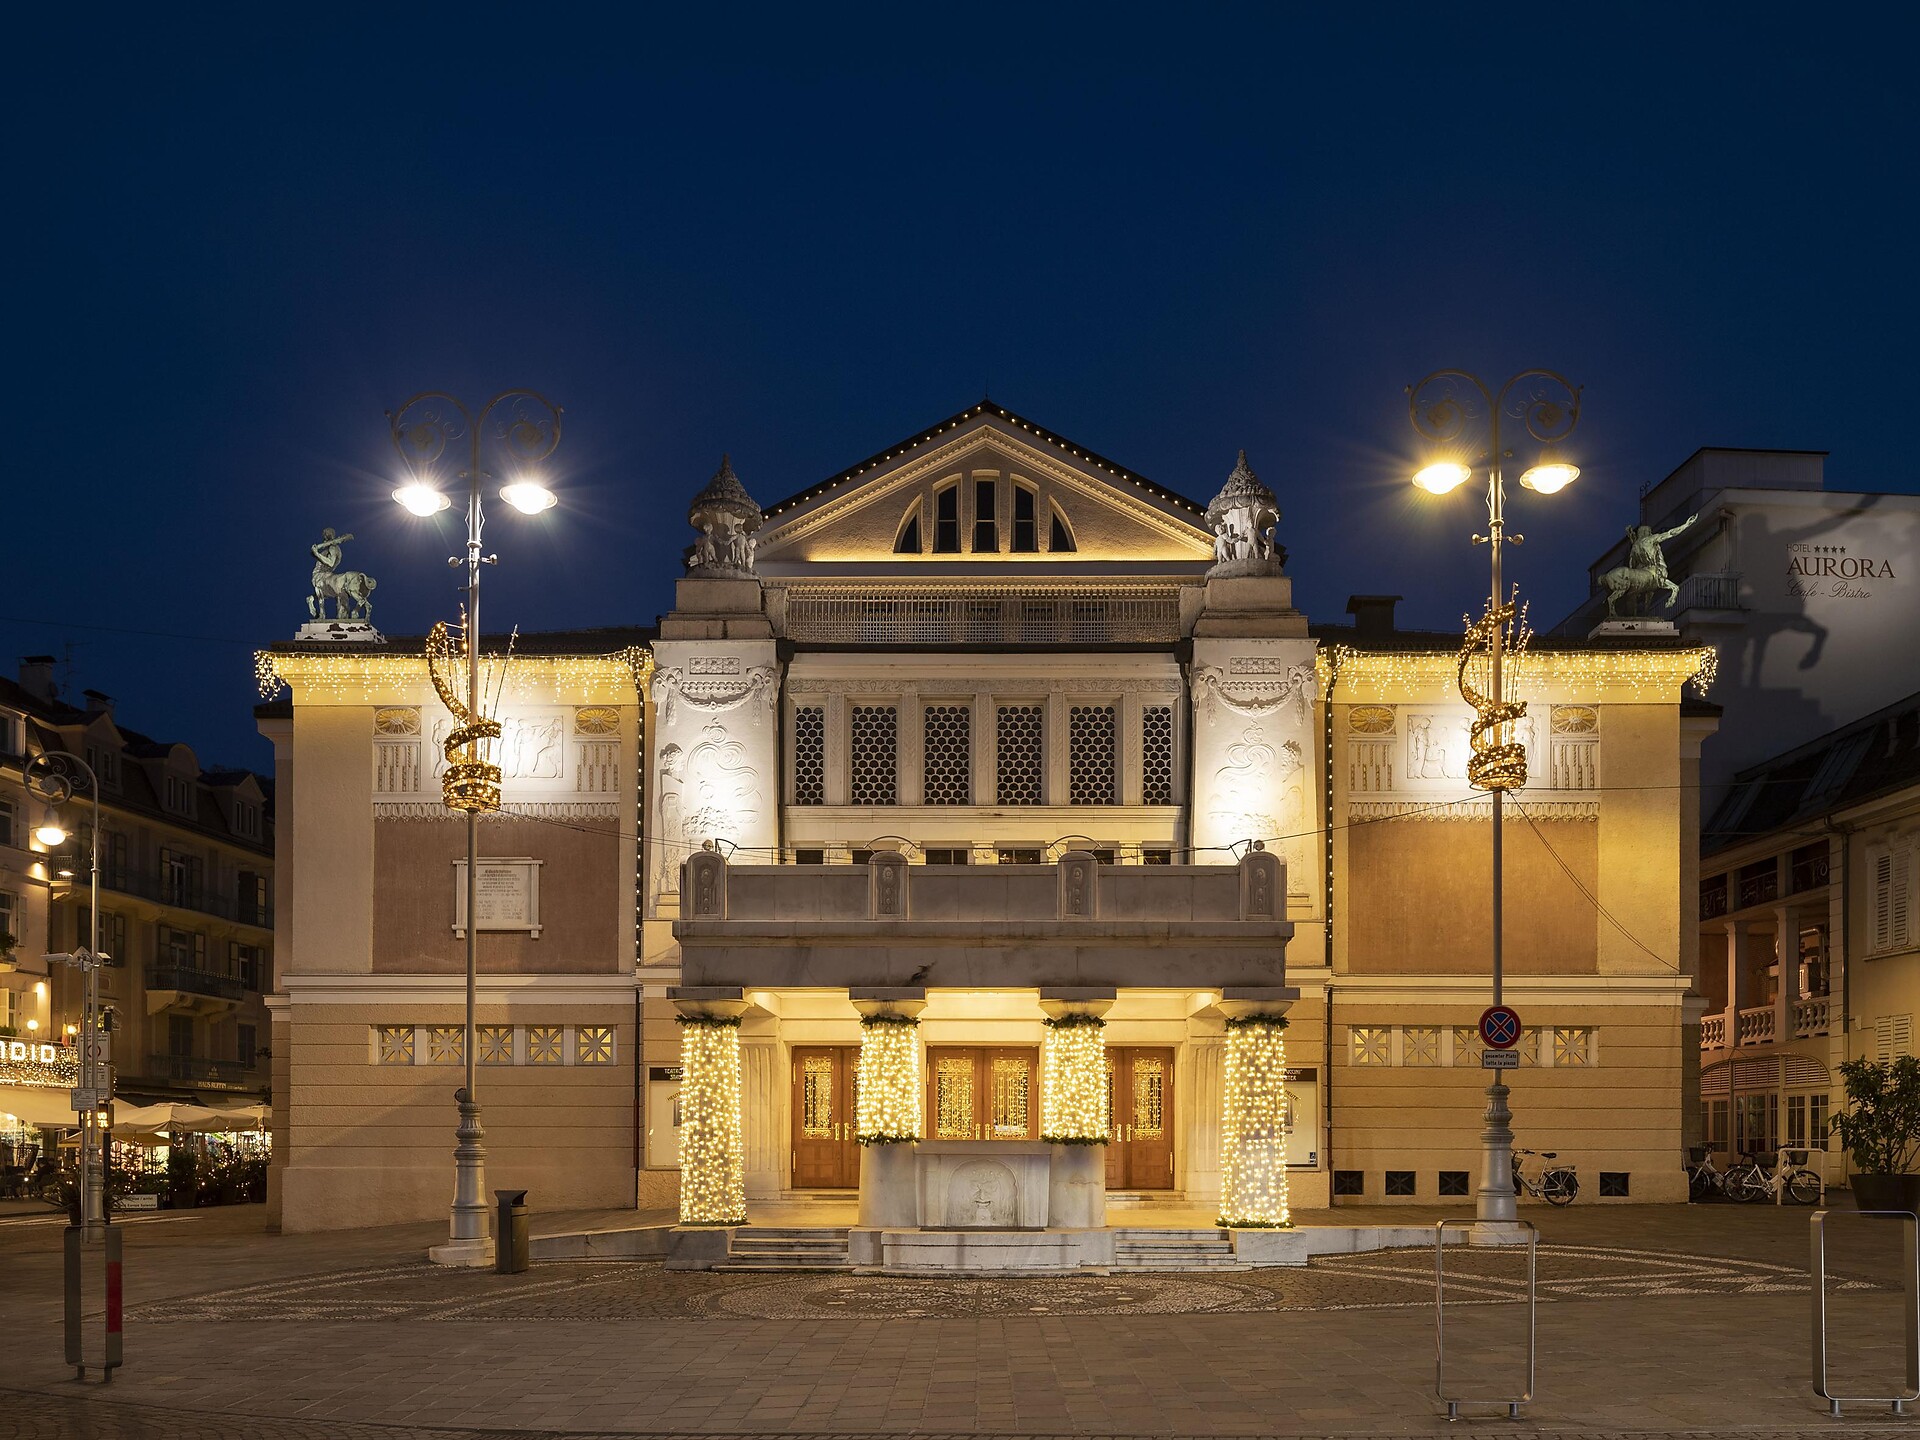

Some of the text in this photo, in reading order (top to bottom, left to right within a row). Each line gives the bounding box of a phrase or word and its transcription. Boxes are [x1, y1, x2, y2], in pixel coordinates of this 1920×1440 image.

[1786, 543, 1811, 553] HOTEL
[1786, 556, 1896, 580] AURORA
[1828, 580, 1872, 599] Bistro
[1284, 1089, 1299, 1102] HEUTE
